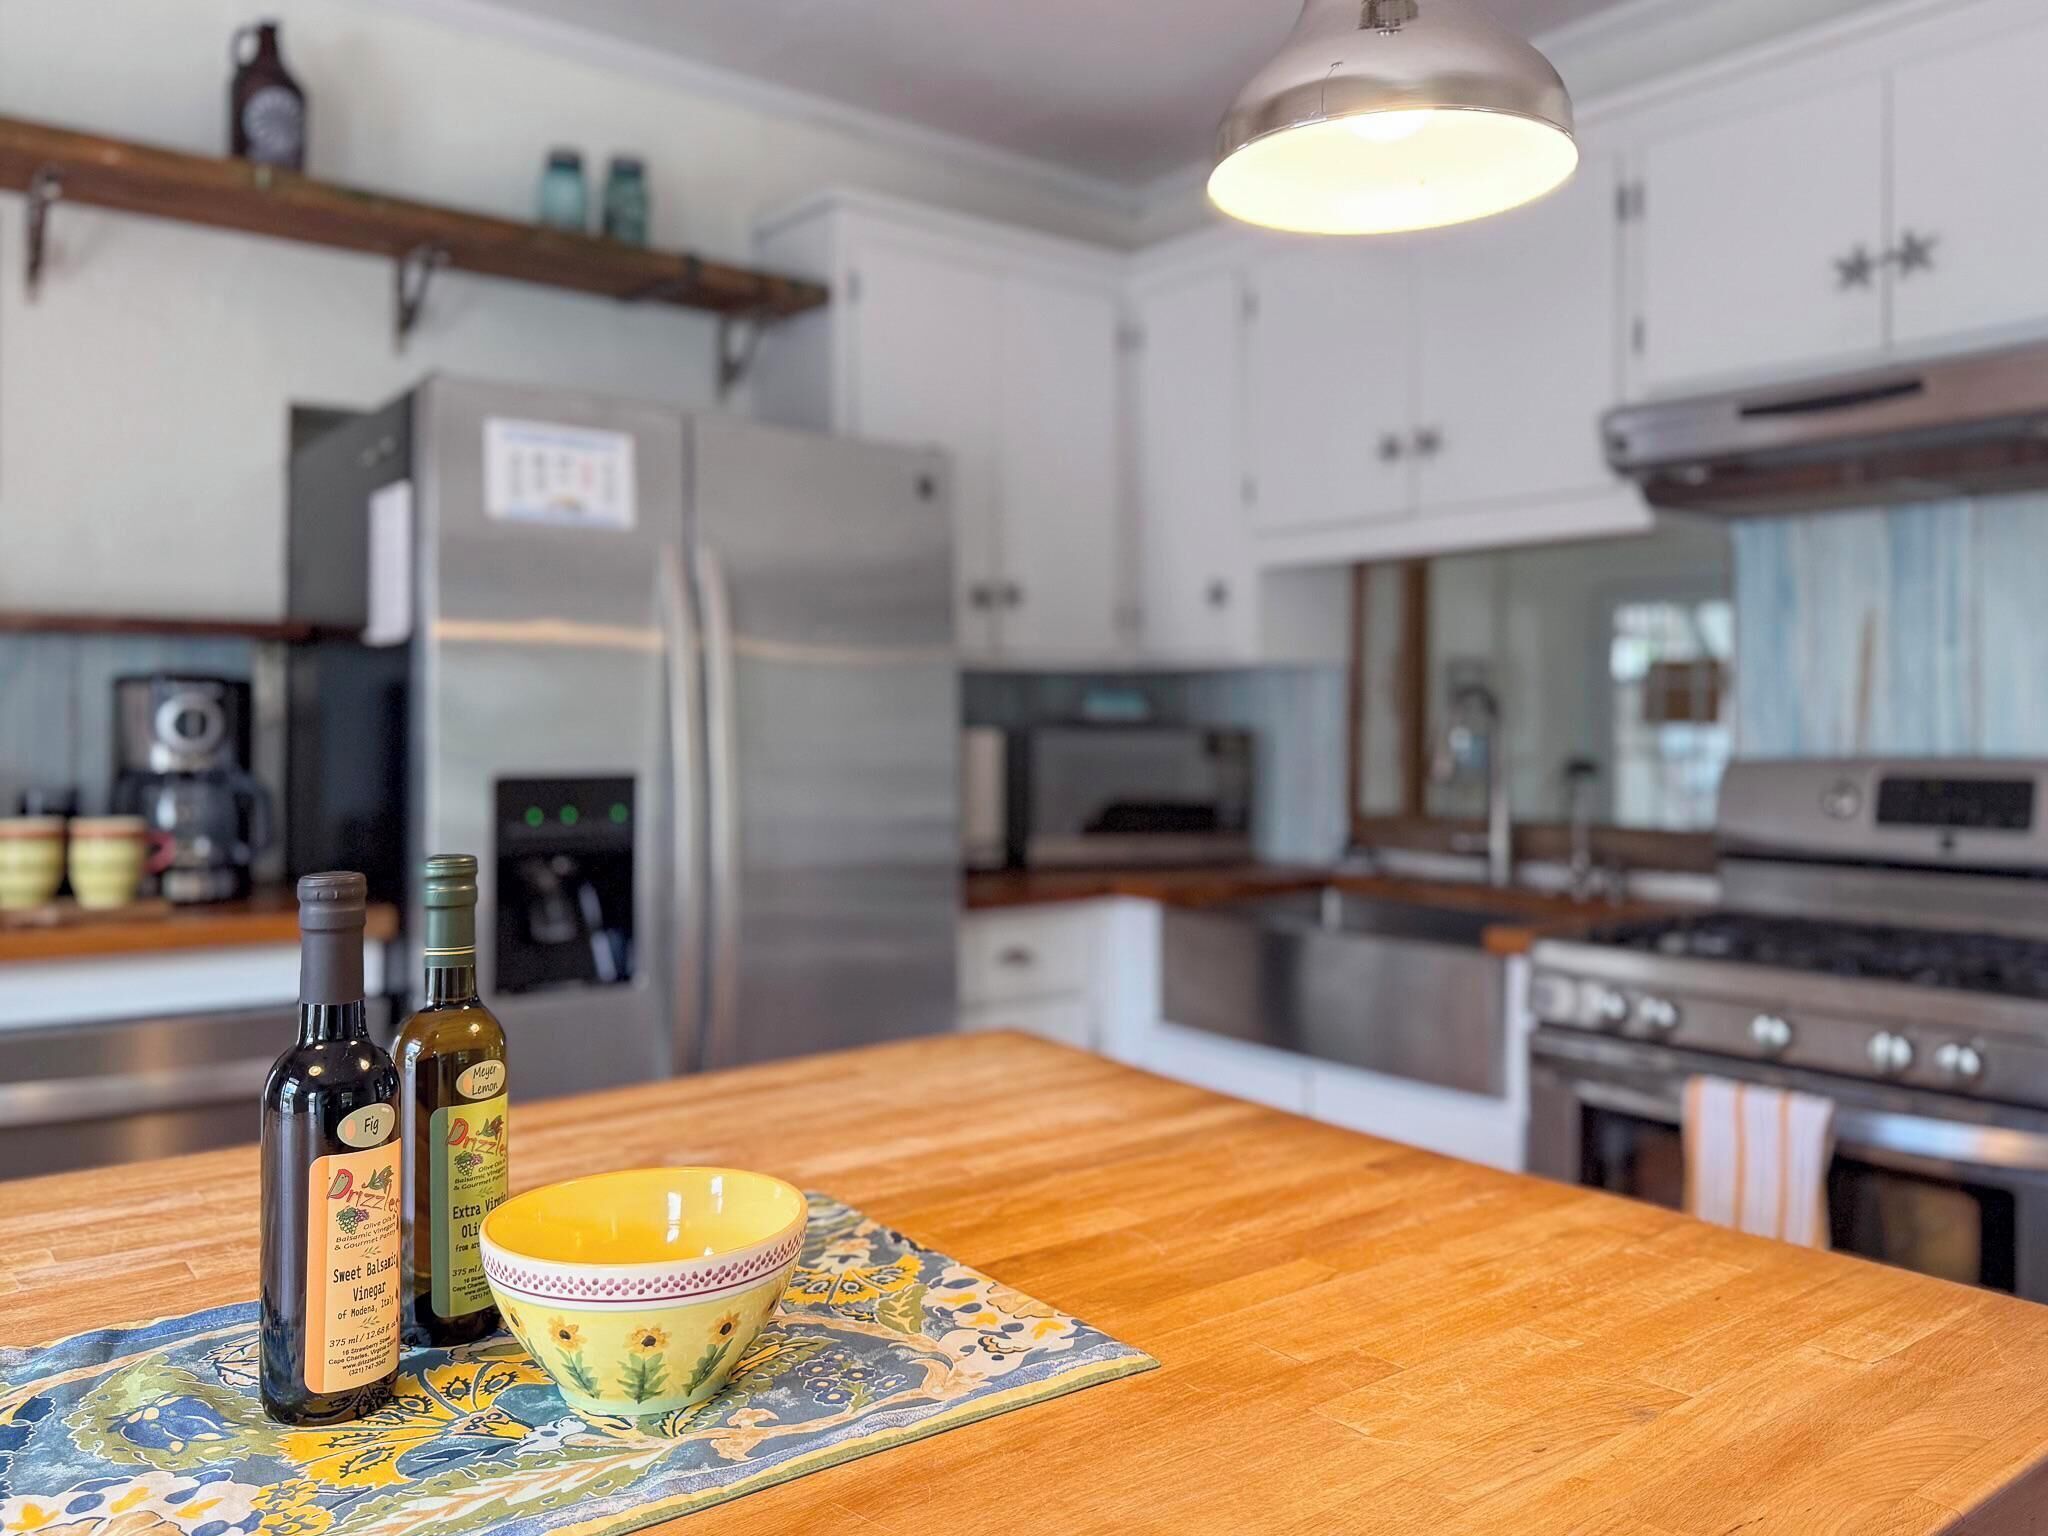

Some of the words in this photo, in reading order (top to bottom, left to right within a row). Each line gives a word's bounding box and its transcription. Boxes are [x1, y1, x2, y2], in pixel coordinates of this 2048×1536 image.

[473, 1065, 497, 1080] Meyer
[472, 1082, 498, 1096] Lemon
[365, 1116, 379, 1135] Fig
[445, 1117, 507, 1157] Drizzle
[461, 1178, 491, 1190] Gourmet
[453, 1205, 481, 1220] Extra
[363, 1220, 381, 1230] Olive
[336, 1231, 372, 1243] Balsamic
[343, 1236, 378, 1250] Gourmet
[455, 1243, 469, 1253] from
[333, 1264, 362, 1284] Sweet
[452, 1268, 467, 1277] 375
[353, 1281, 387, 1302] Vinegar
[337, 1309, 348, 1320] of
[351, 1304, 378, 1318] Modena,
[381, 1294, 394, 1309] Italy
[329, 1337, 346, 1348] 375
[348, 1334, 359, 1345] ml
